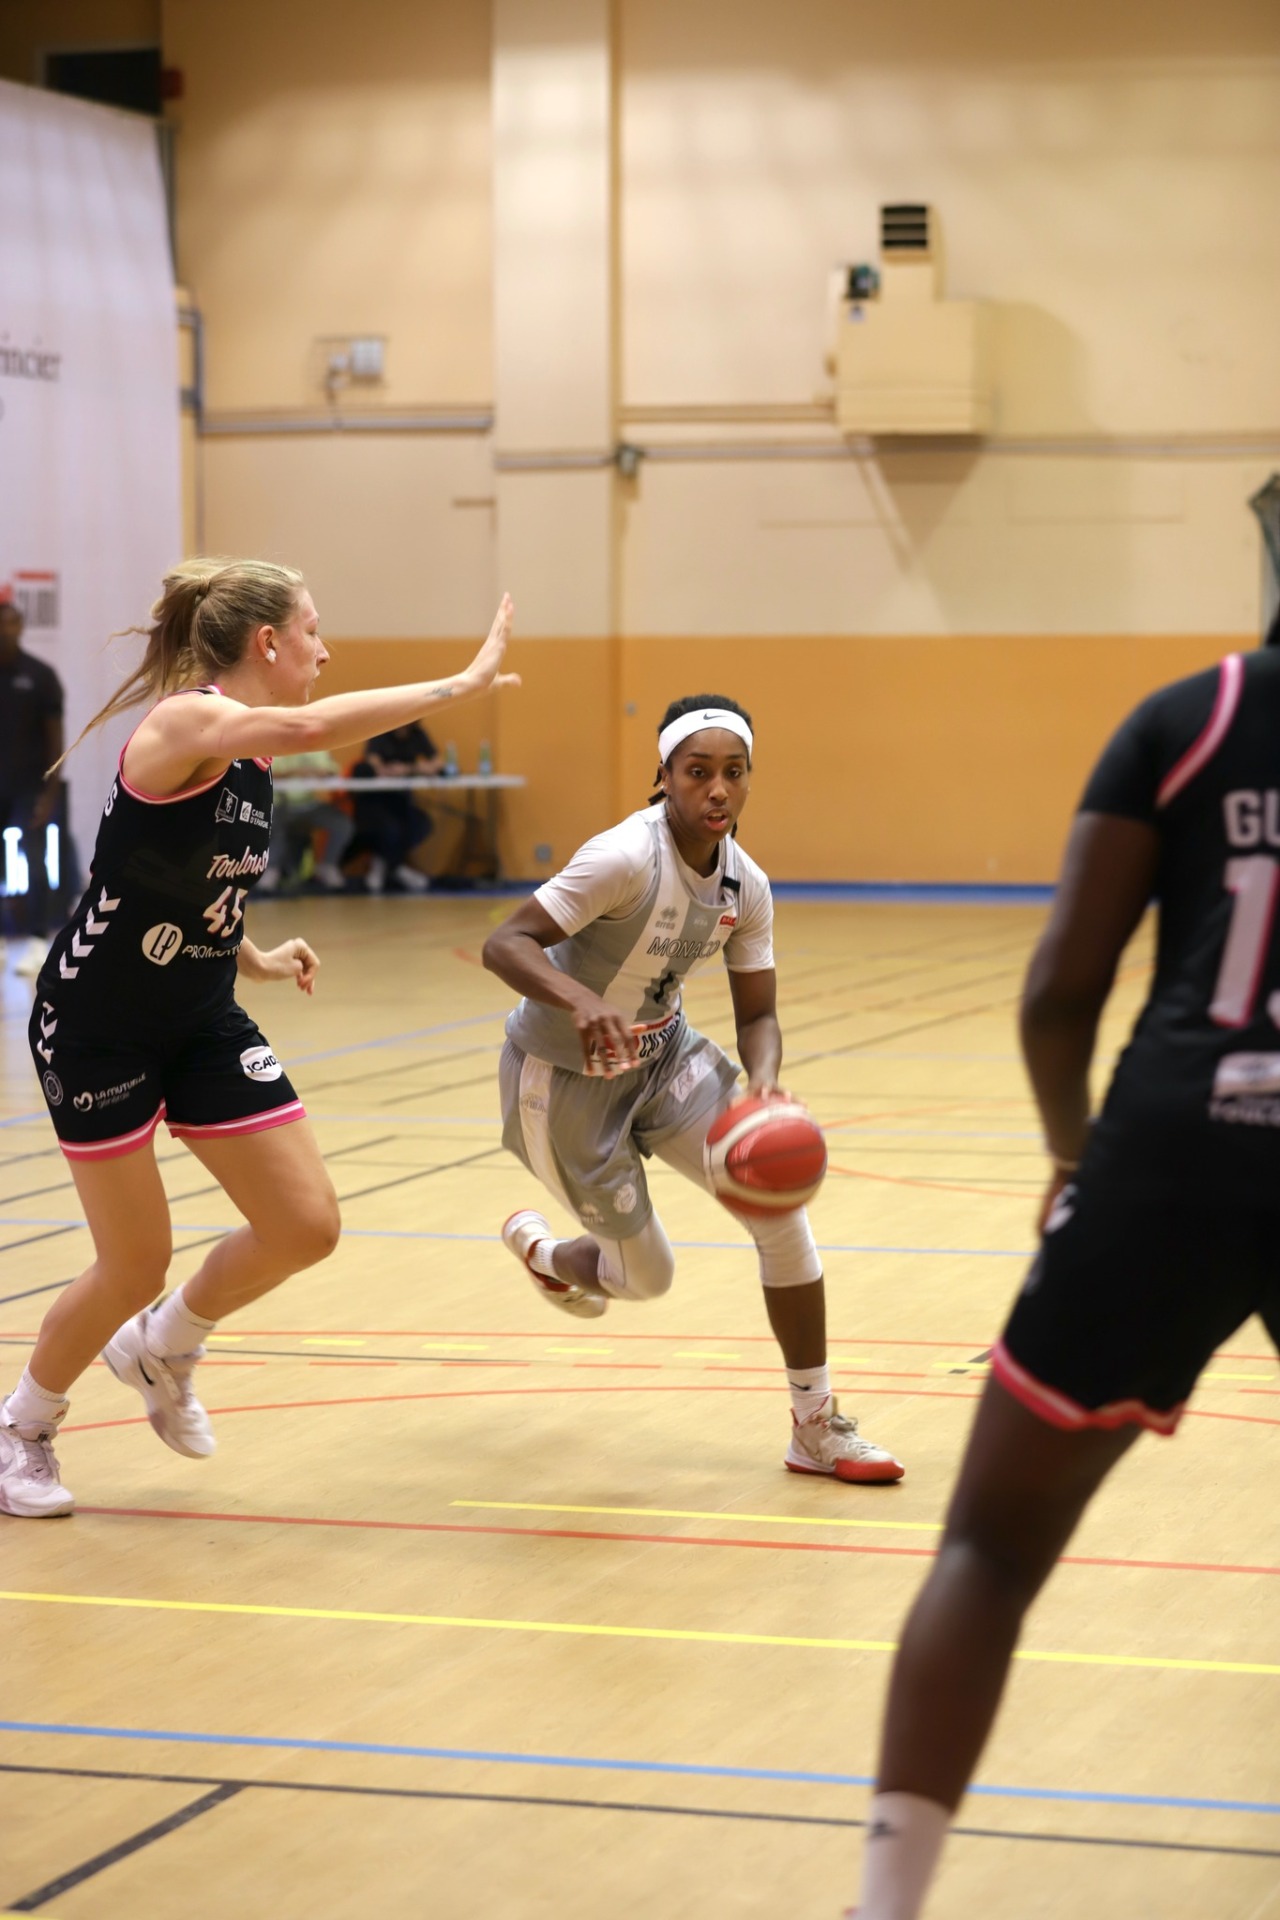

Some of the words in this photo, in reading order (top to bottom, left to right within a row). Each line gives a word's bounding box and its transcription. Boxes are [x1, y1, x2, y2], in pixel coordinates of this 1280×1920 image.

[203, 885, 248, 938] 45
[149, 925, 178, 961] LP
[646, 936, 721, 959] MONACO
[1207, 856, 1280, 1028] 1
[246, 1055, 279, 1074] ICAD
